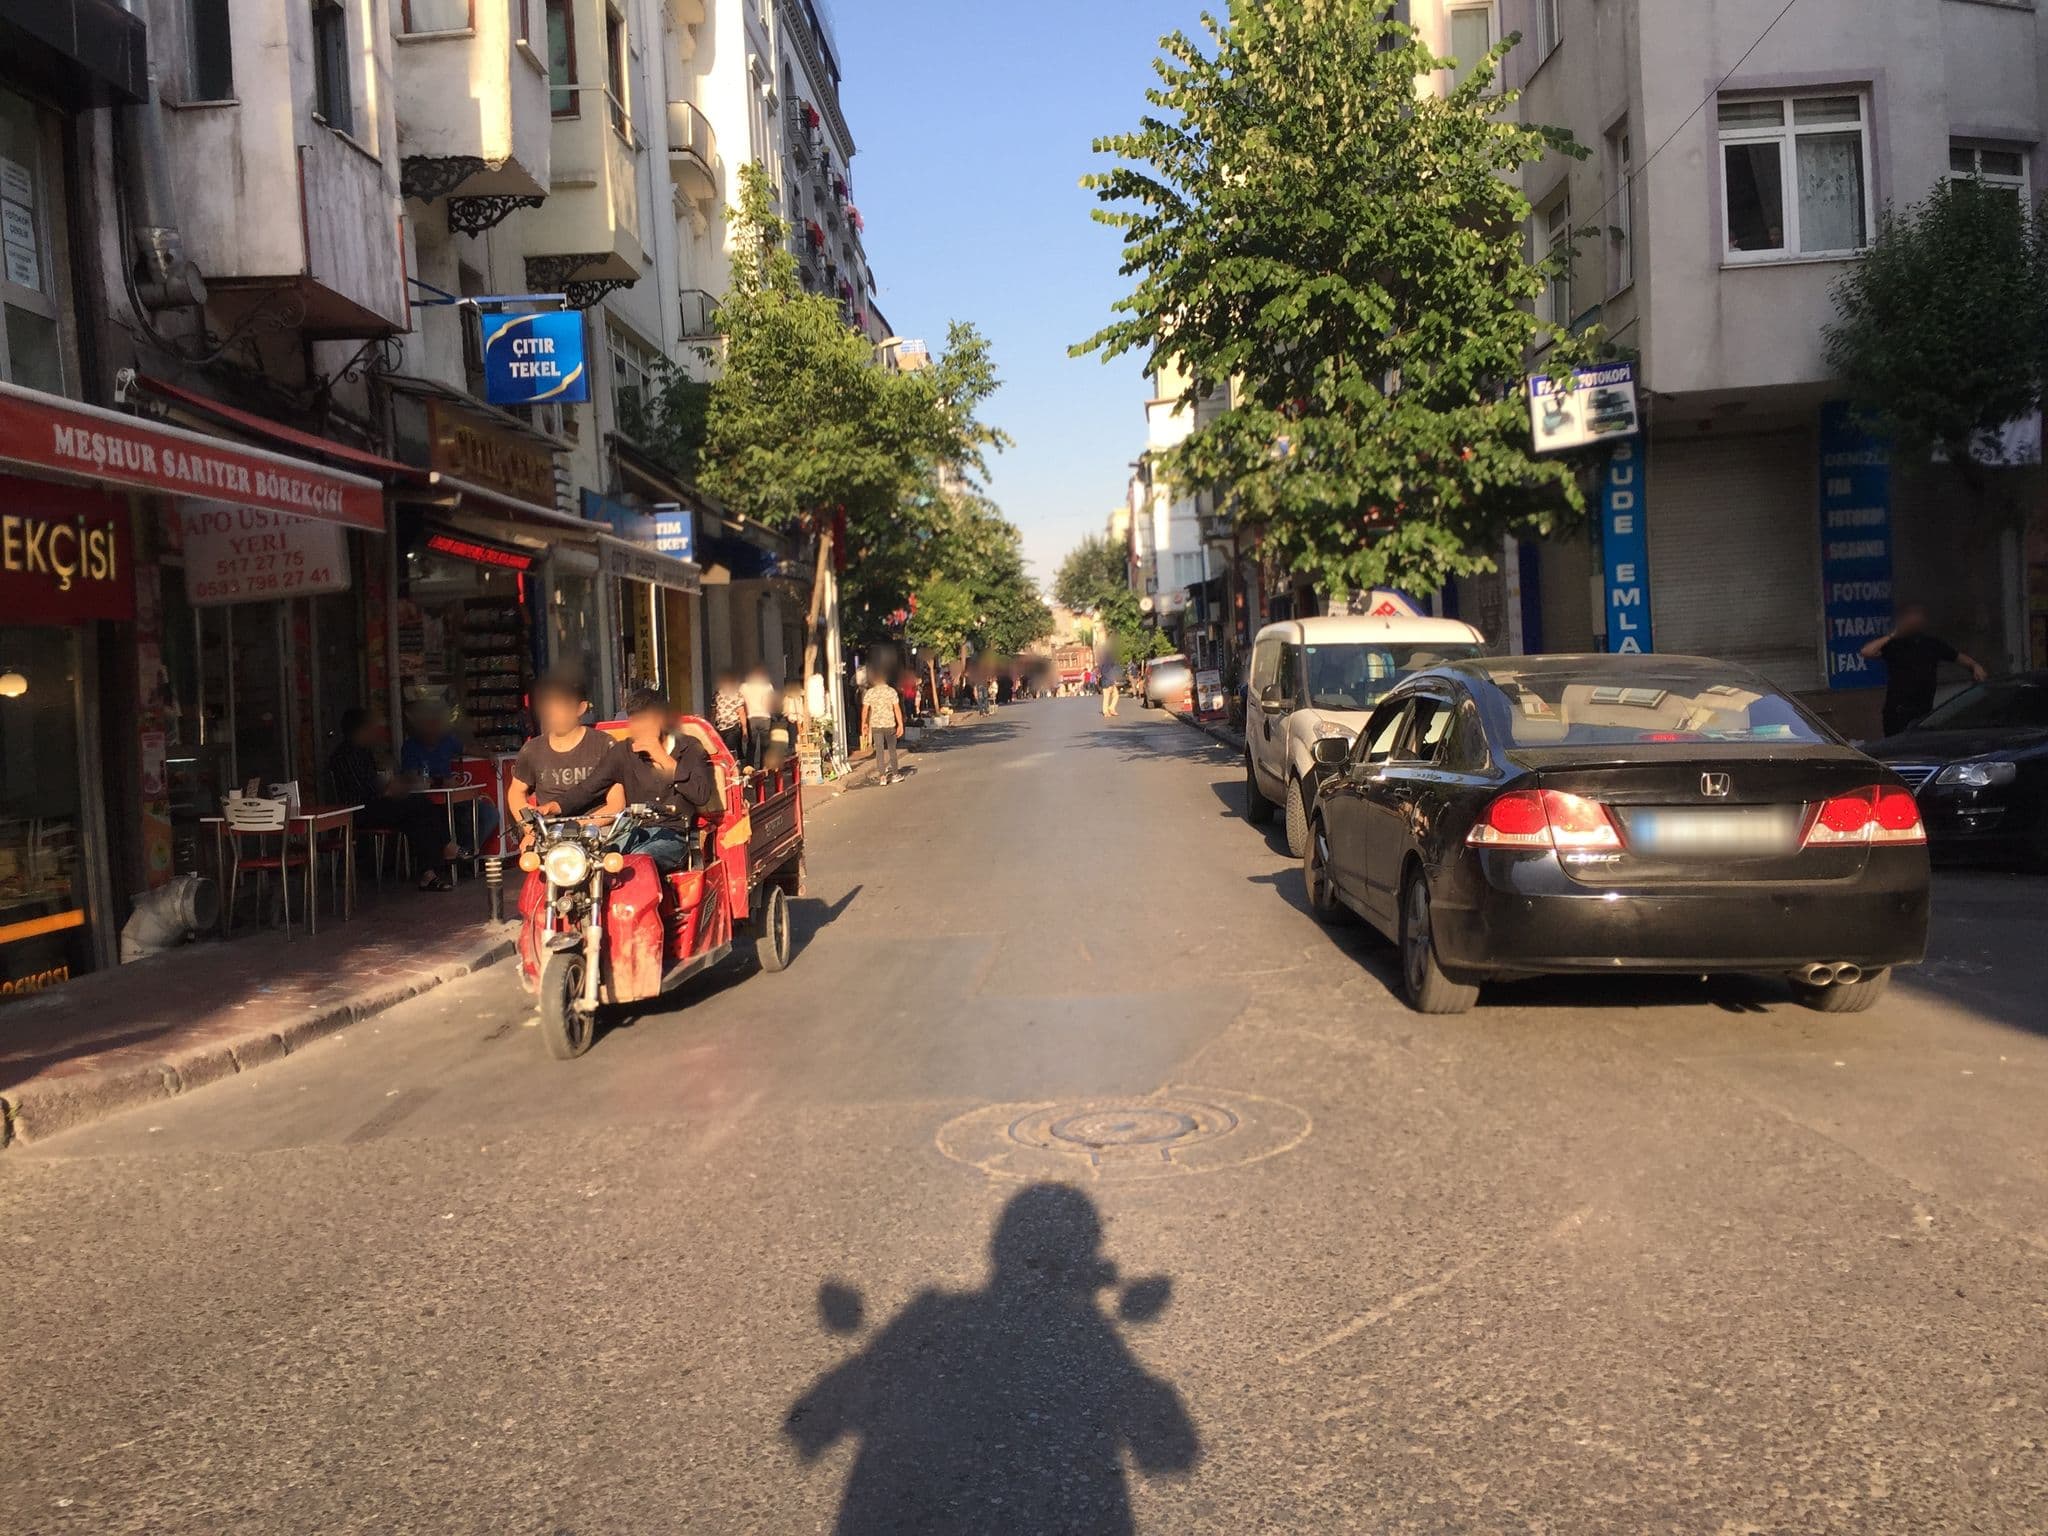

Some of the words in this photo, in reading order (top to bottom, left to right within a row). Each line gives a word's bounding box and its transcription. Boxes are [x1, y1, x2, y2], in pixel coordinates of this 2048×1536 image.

[508, 361, 561, 378] TEKEL
[512, 337, 556, 358] ÇITIR
[53, 423, 157, 472] MEŞHUR
[162, 448, 251, 494] SARIYER
[255, 467, 344, 515] BÖREKÇİSİ
[1610, 443, 1634, 535] SUDE
[3, 514, 116, 591] EKÇİSİ
[1838, 652, 1867, 672] FAX
